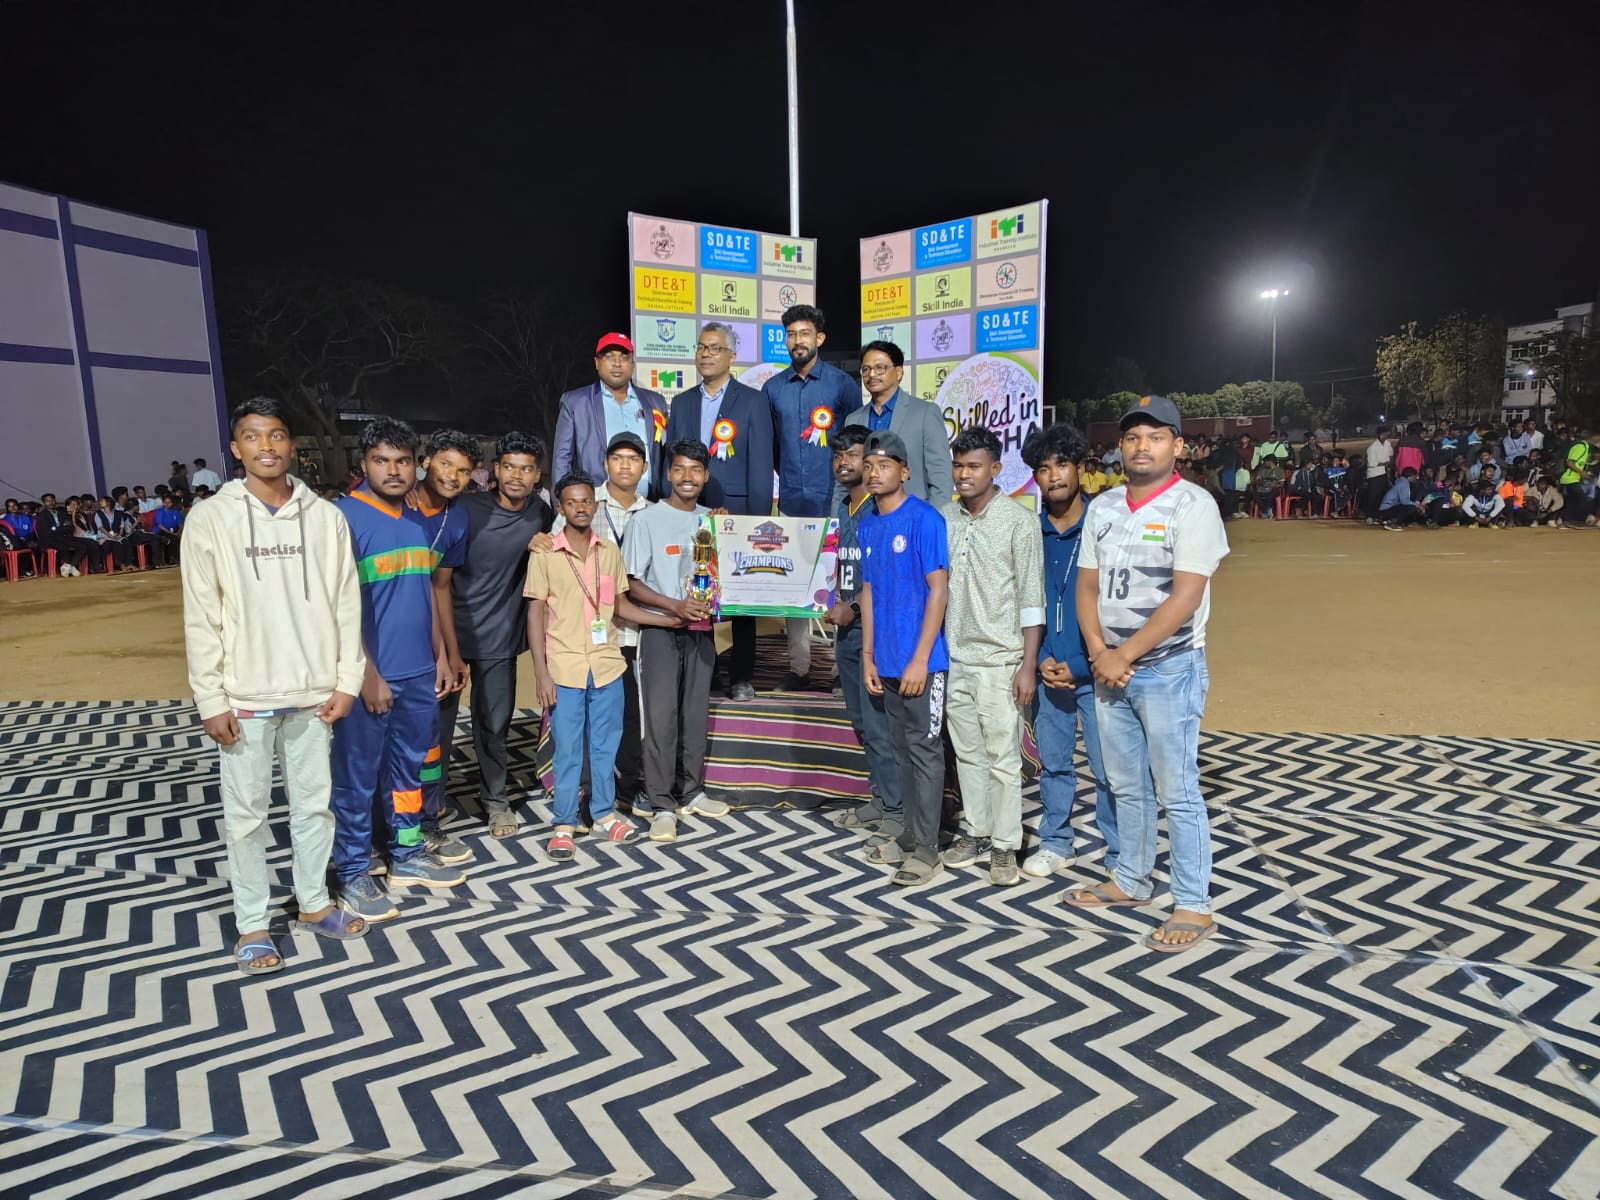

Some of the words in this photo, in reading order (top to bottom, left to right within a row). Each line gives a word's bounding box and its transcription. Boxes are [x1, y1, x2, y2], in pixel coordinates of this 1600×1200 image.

[643, 275, 687, 292] DTE&T
[867, 285, 903, 302] DTE&T
[708, 304, 727, 314] Skill
[729, 305, 750, 316] India
[922, 300, 940, 312] Skill
[942, 298, 964, 310] India
[943, 394, 1015, 440] Skilled
[1020, 392, 1039, 420] in
[740, 555, 794, 572] CHAMPIONS
[840, 565, 854, 590] 12
[1107, 567, 1131, 600] 13
